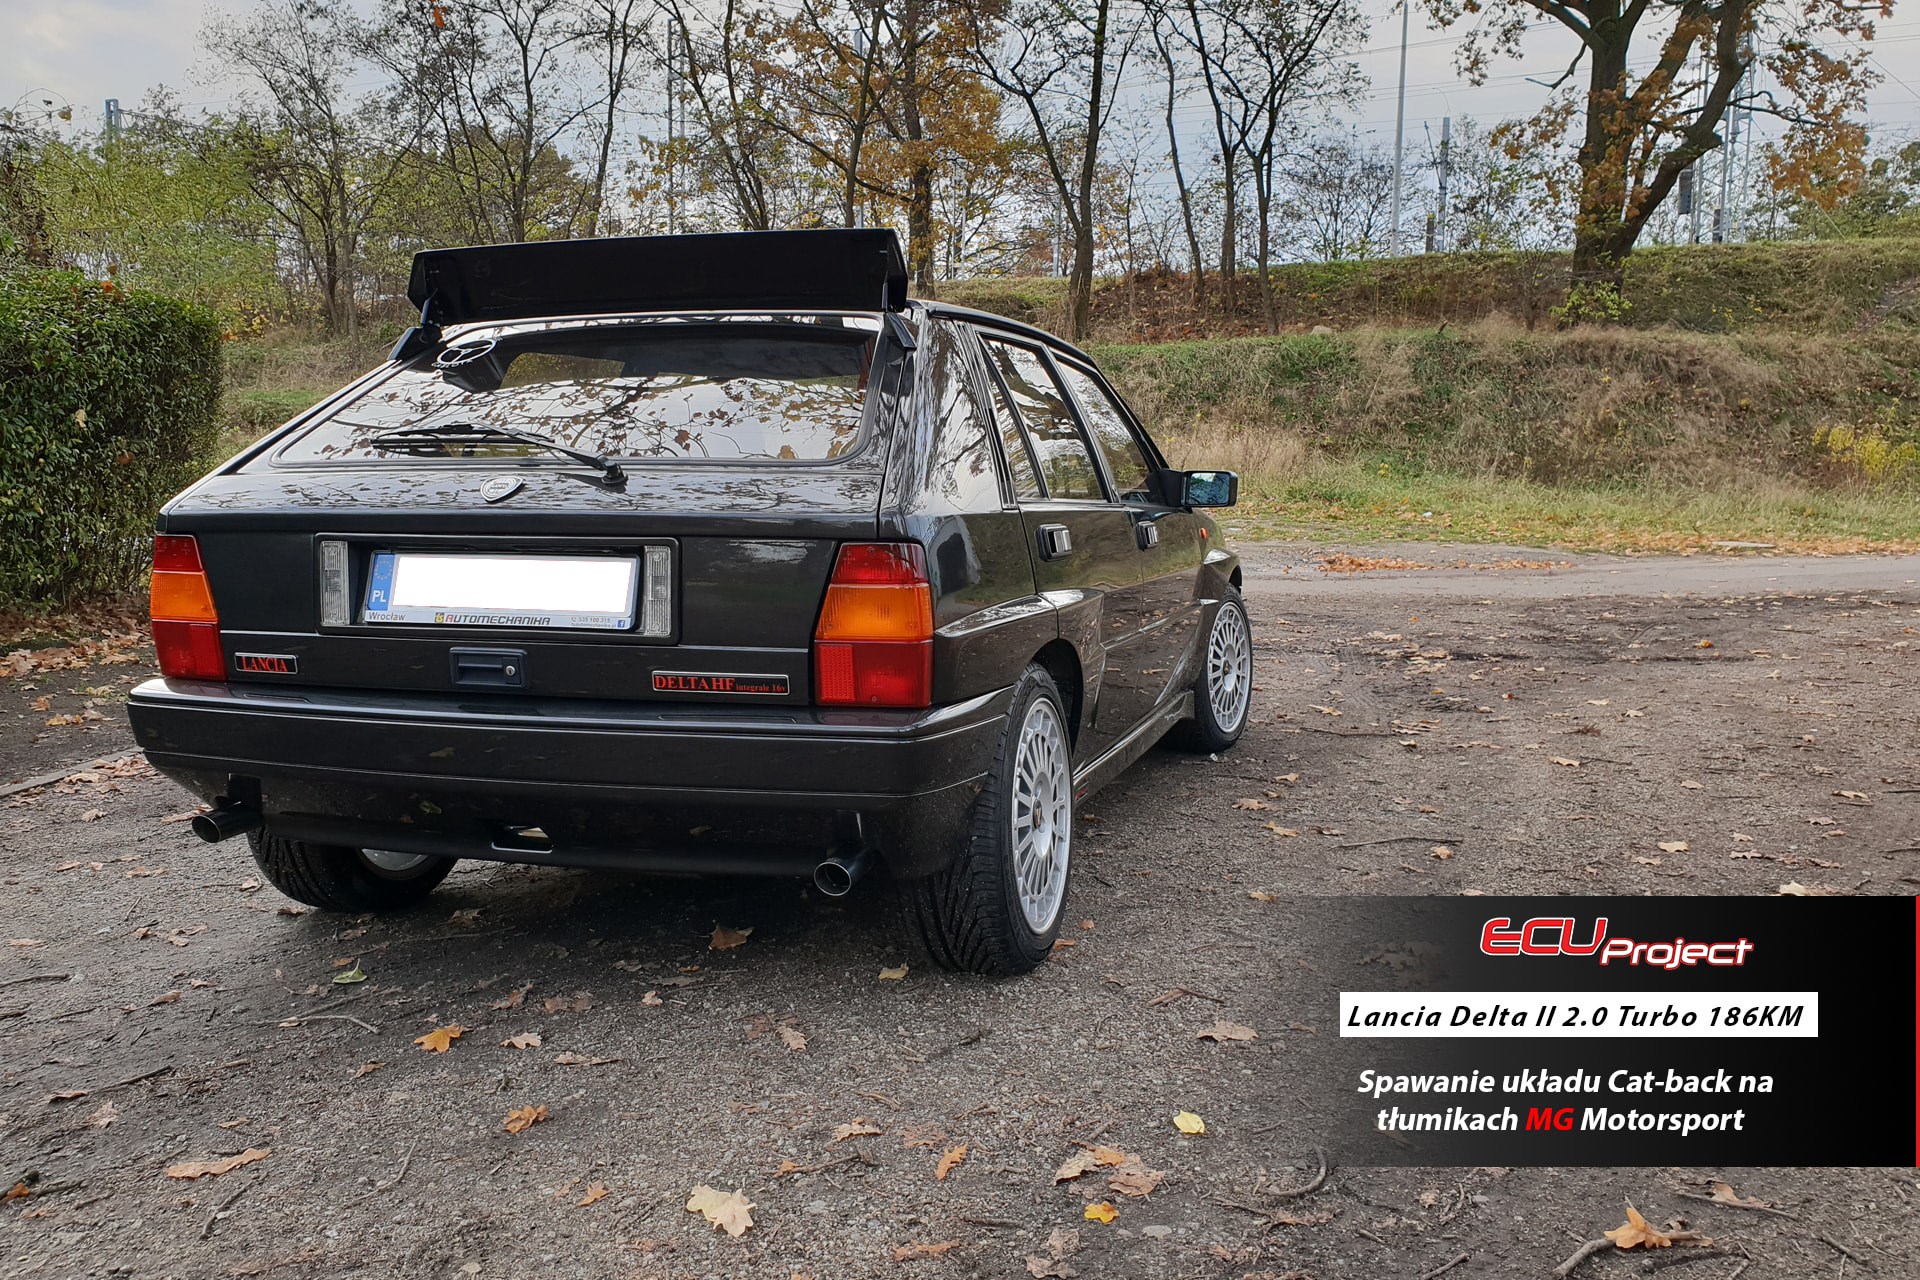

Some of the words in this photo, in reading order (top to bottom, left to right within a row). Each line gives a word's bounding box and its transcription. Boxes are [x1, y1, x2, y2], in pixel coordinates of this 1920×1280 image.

[372, 590, 387, 602] PL
[369, 611, 406, 621] Wrocław
[241, 656, 288, 672] LANCIA
[654, 675, 710, 690] DELTA
[711, 677, 735, 690] HF
[736, 683, 769, 693] integrale
